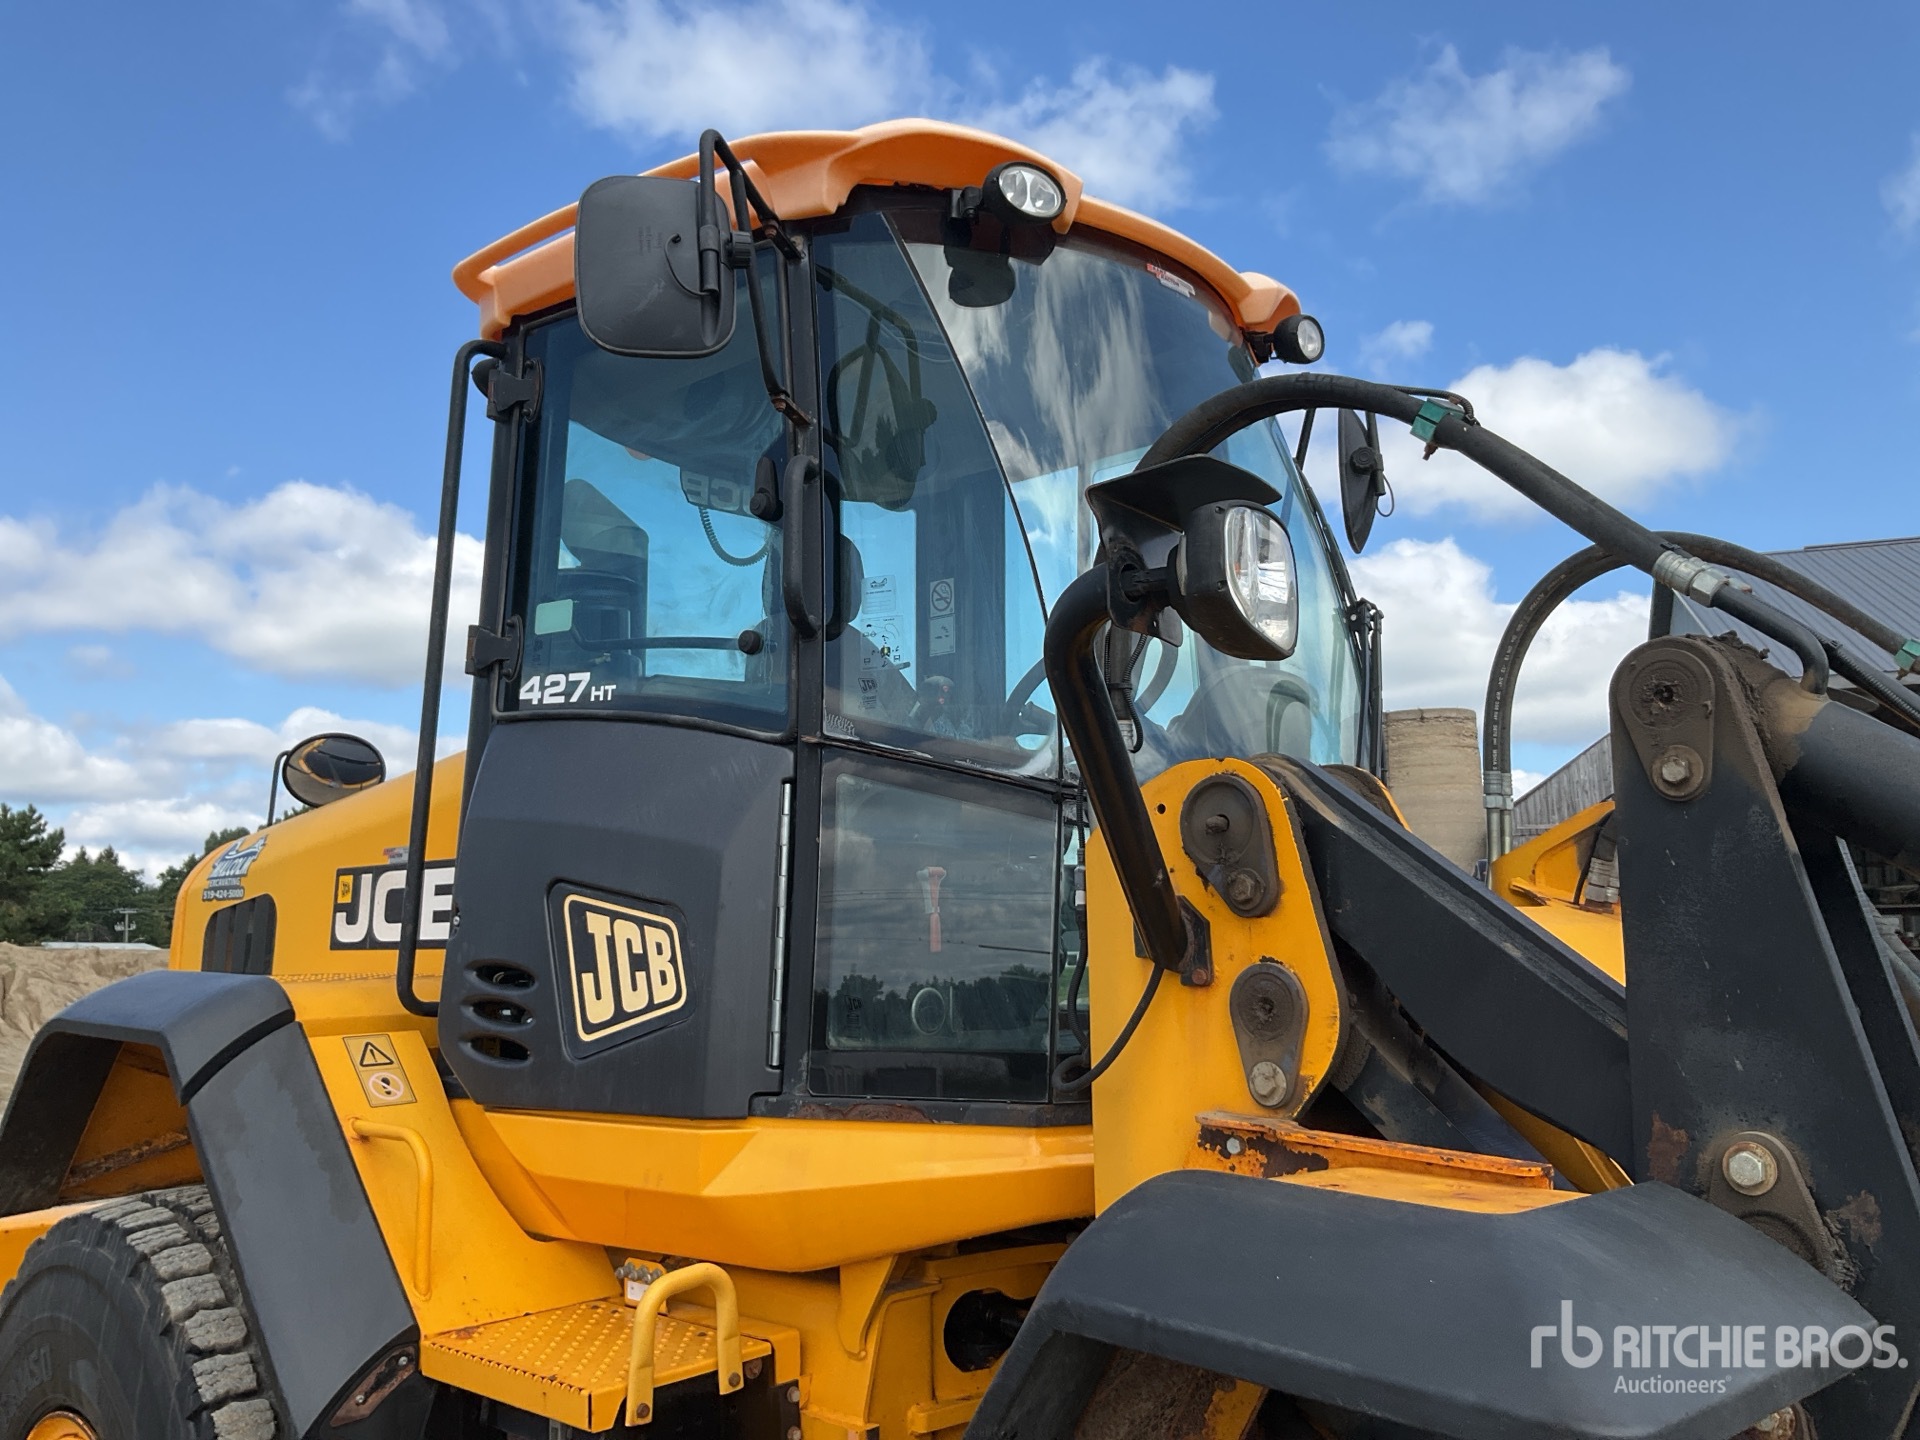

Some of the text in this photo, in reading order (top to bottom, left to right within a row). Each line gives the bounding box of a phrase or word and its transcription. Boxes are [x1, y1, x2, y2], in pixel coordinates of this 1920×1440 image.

[519, 672, 617, 705] 427 HT
[581, 911, 677, 1024] JCB
